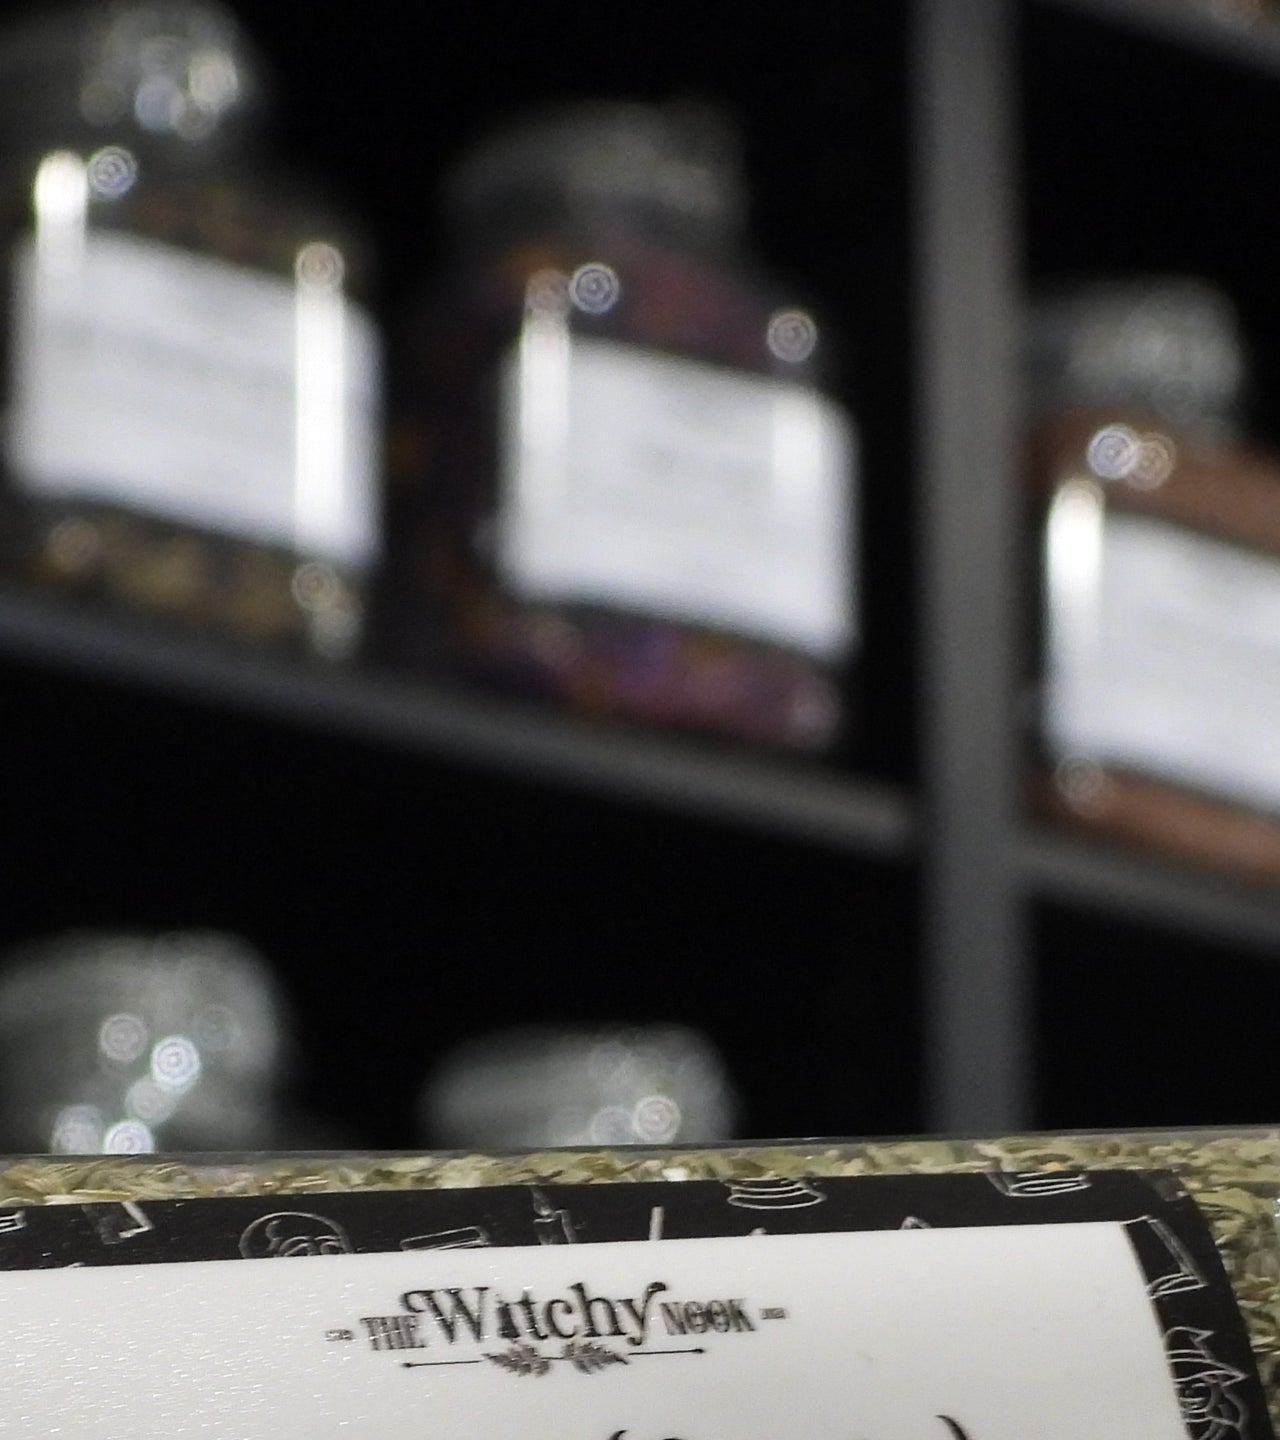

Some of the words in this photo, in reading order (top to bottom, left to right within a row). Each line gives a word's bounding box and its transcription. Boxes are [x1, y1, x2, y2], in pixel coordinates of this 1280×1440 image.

[360, 1315, 428, 1351] THE
[400, 1282, 667, 1346] Witchy
[659, 1298, 756, 1336] NOOK
